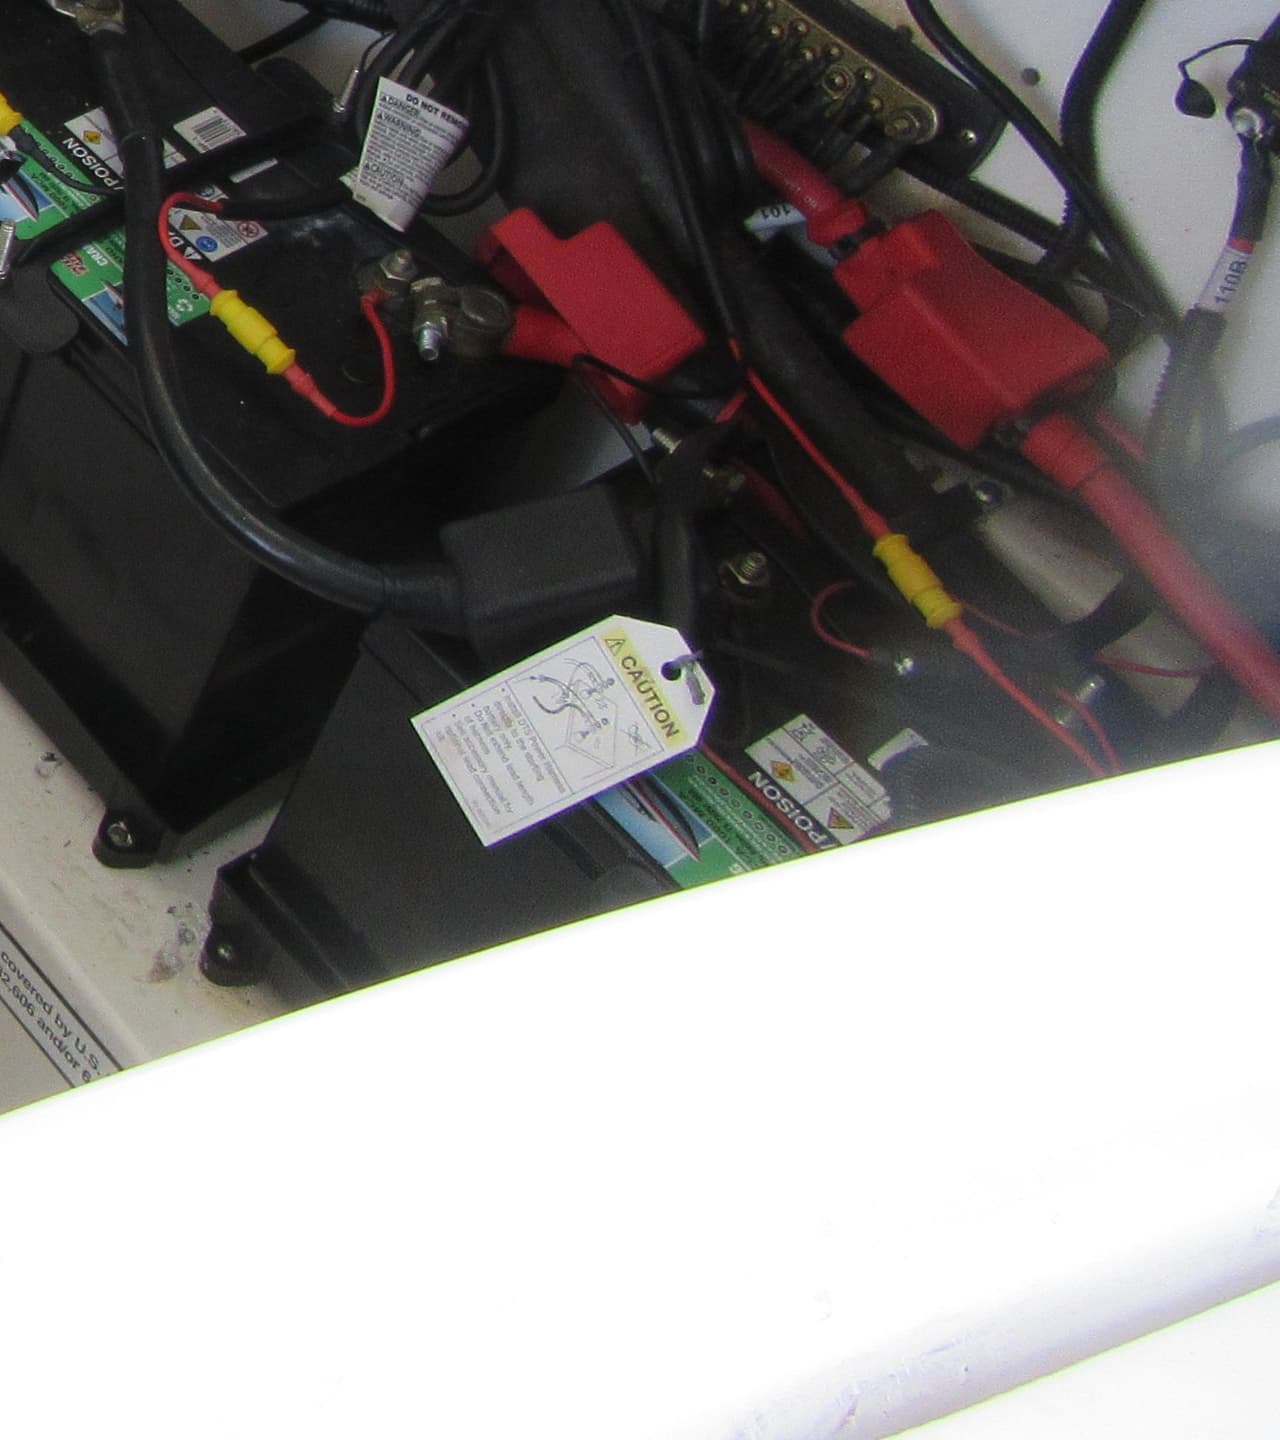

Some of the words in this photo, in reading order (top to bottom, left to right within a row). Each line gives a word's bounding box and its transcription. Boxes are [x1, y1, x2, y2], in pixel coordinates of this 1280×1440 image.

[388, 97, 420, 118] DANGER
[406, 93, 420, 105] DO
[420, 99, 440, 115] NOT
[384, 112, 422, 138] WARNING
[370, 163, 405, 186] CAUTION
[1214, 260, 1248, 303] 110B
[621, 655, 680, 739] CAUTION
[517, 717, 532, 736] DTS
[1, 950, 53, 1015] covered
[54, 1013, 72, 1038] by
[74, 1037, 101, 1076] U.S.
[36, 1017, 80, 1069] and/or
